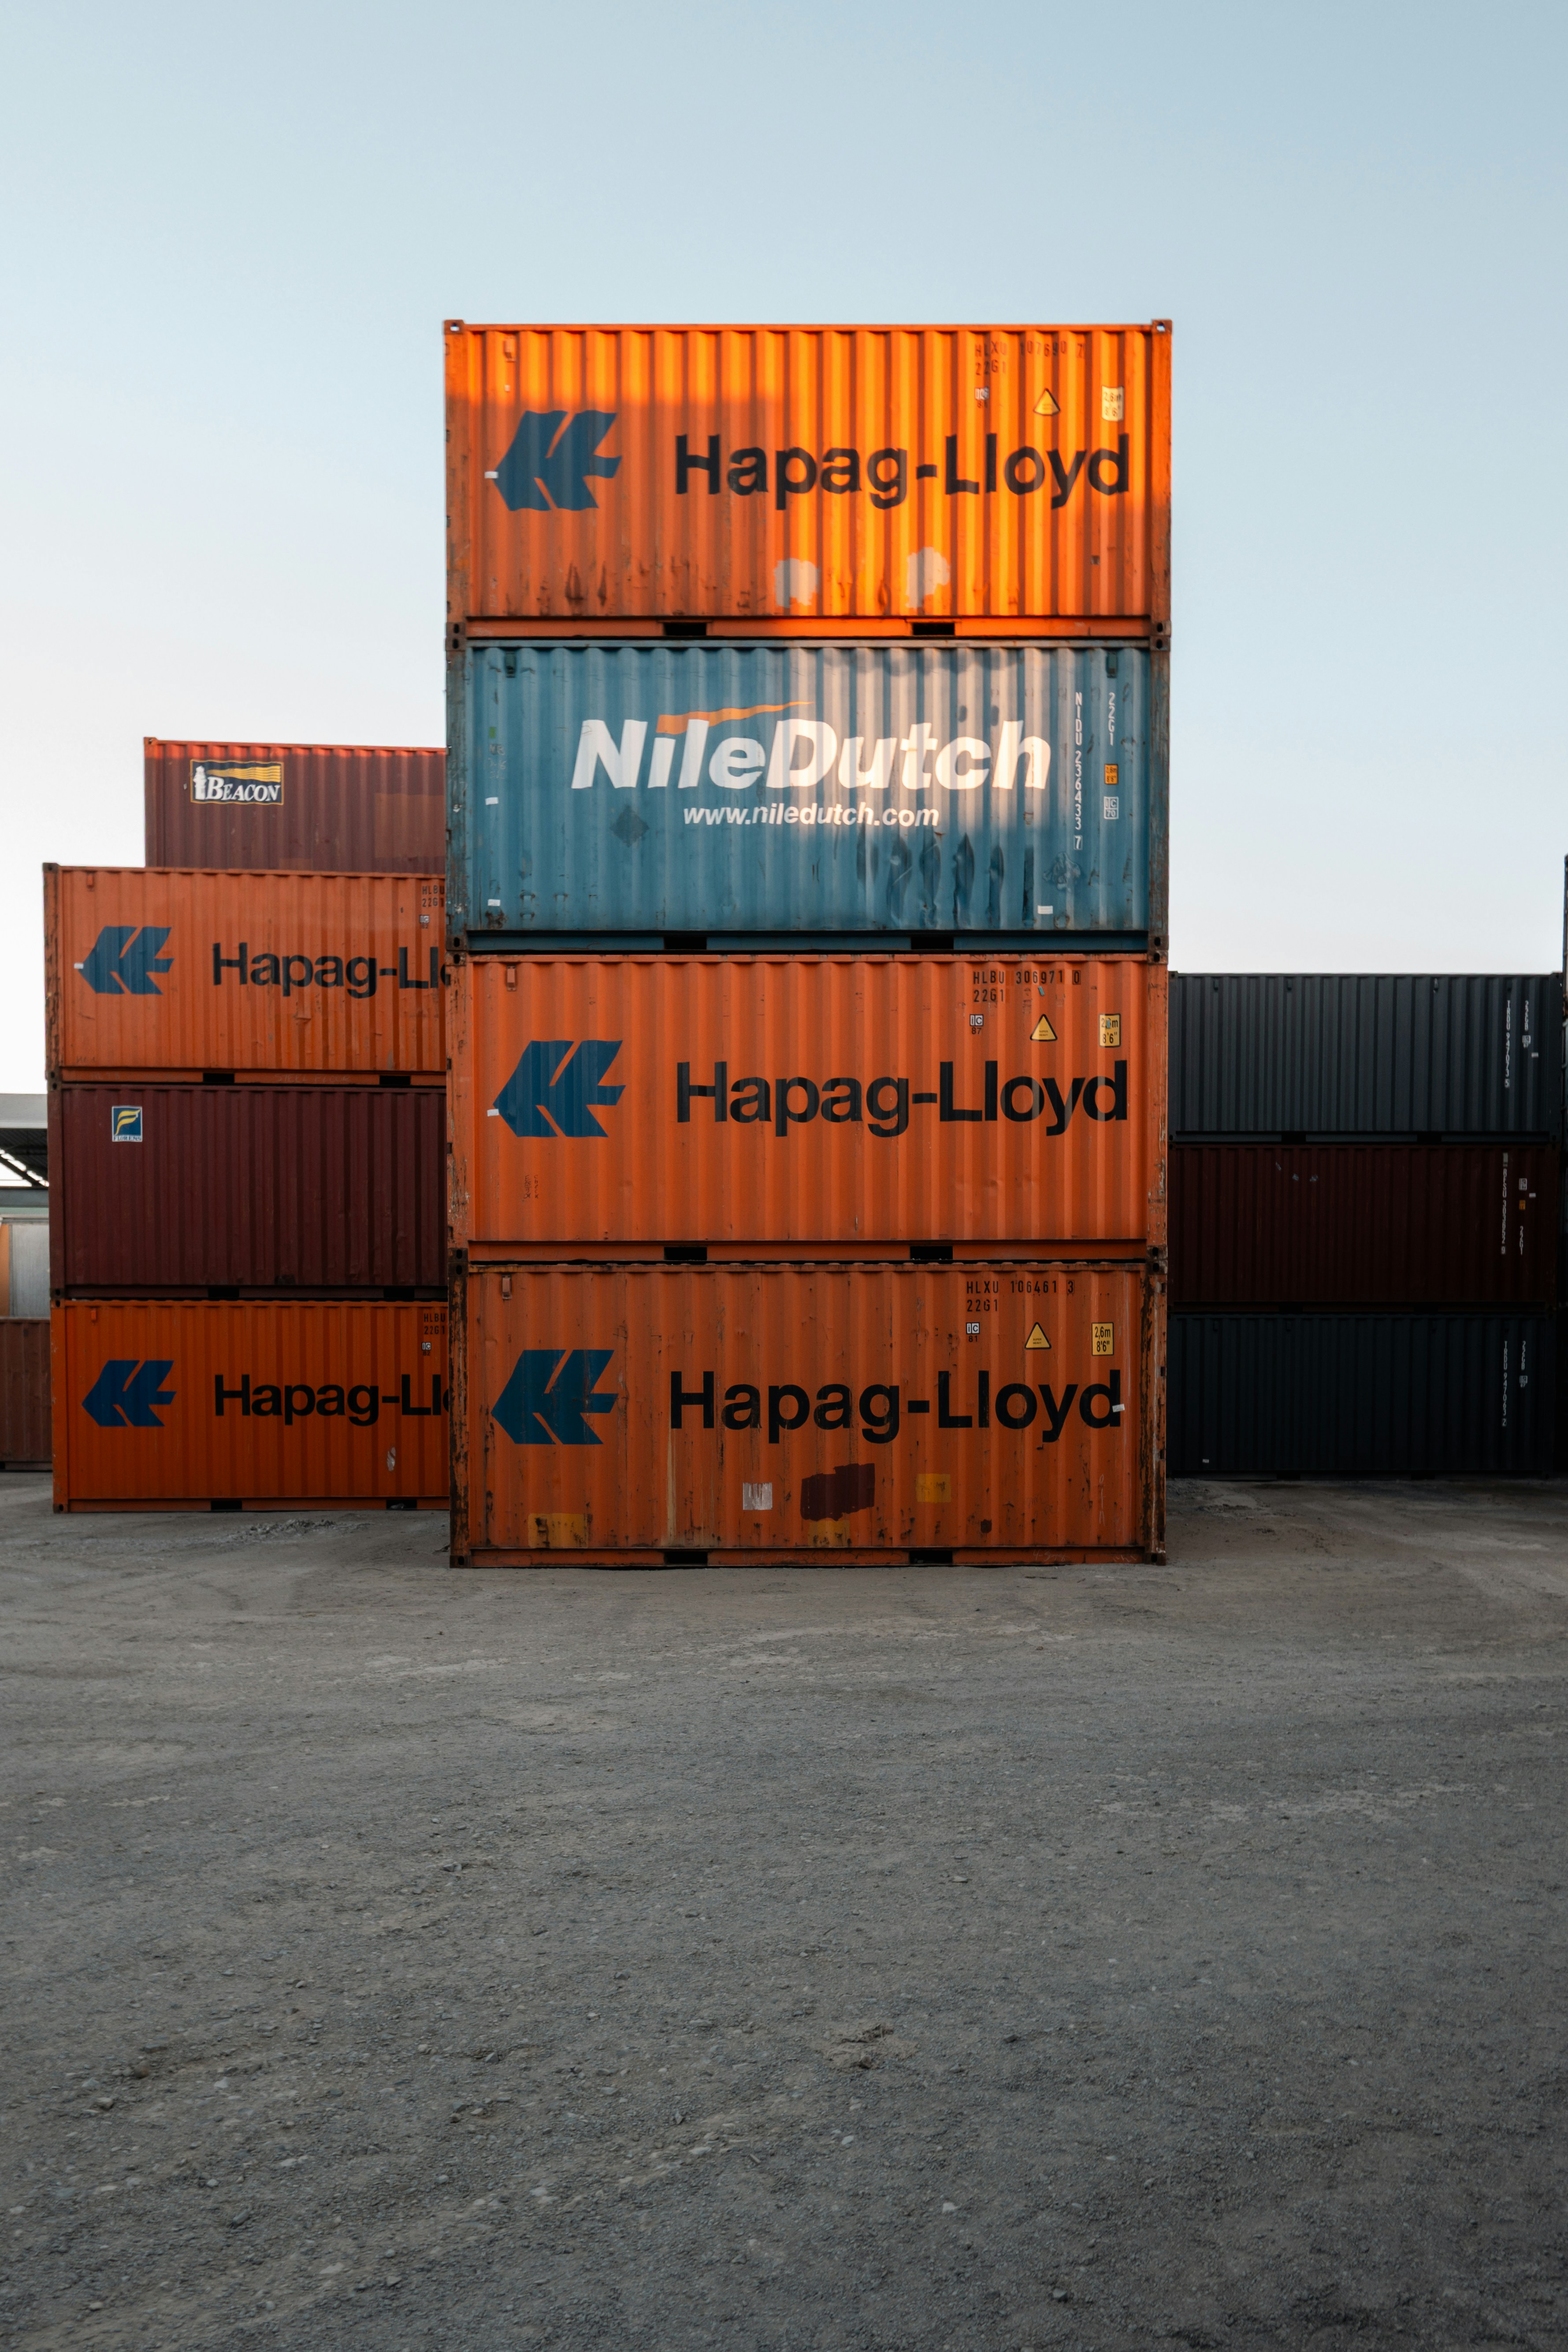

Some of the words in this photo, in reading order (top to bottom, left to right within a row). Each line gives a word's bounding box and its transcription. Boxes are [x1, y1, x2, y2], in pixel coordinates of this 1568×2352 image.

[975, 342, 1007, 357] HLXU
[1021, 341, 1066, 357] 107690
[975, 360, 1007, 375] 22G1
[676, 433, 1130, 511] Hapag-Lloyd
[571, 718, 1051, 790] NileDutch
[205, 776, 282, 802] BEACON
[684, 802, 939, 827] www.niledutch.com
[1076, 836, 1081, 849] 7
[422, 884, 445, 895] HLBU
[422, 897, 444, 907] 22G1
[212, 942, 446, 999] Hapag-Ll
[973, 970, 1005, 984] HLBU
[1015, 970, 1063, 984] 306971
[973, 988, 1004, 1002] 22G1
[677, 1060, 1127, 1137] Hapag-Lloyd
[966, 1281, 999, 1294] HLXU
[1011, 1280, 1057, 1293] 106461
[1067, 1280, 1074, 1293] 3
[966, 1299, 998, 1312] 22G1
[424, 1313, 446, 1323] HLBU
[424, 1325, 445, 1335] 22G1
[1095, 1326, 1111, 1339] 2,6m
[1096, 1341, 1111, 1352] 8'6"
[215, 1374, 449, 1427] Hapag-Ll
[671, 1369, 1121, 1444] Hapag-Lloyd
[1502, 1418, 1507, 1427] 2
